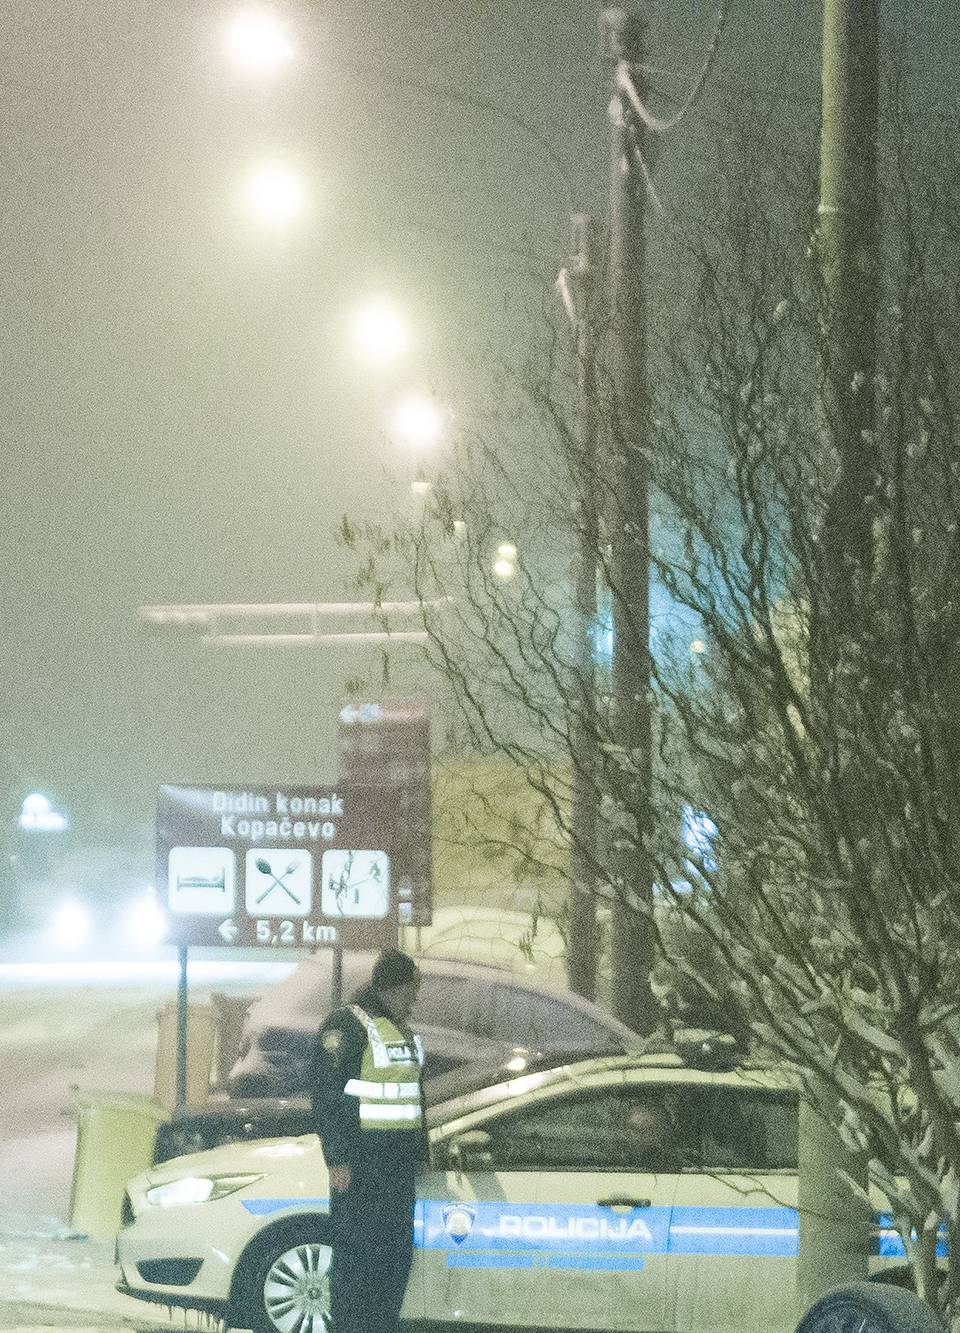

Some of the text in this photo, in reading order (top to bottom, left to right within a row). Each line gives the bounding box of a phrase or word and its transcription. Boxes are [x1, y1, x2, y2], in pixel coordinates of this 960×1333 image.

[212, 790, 344, 815] Didin konak
[220, 814, 337, 841] Kopačevo
[256, 919, 338, 945] 5,2 km
[499, 1214, 652, 1240] POLICIJA
